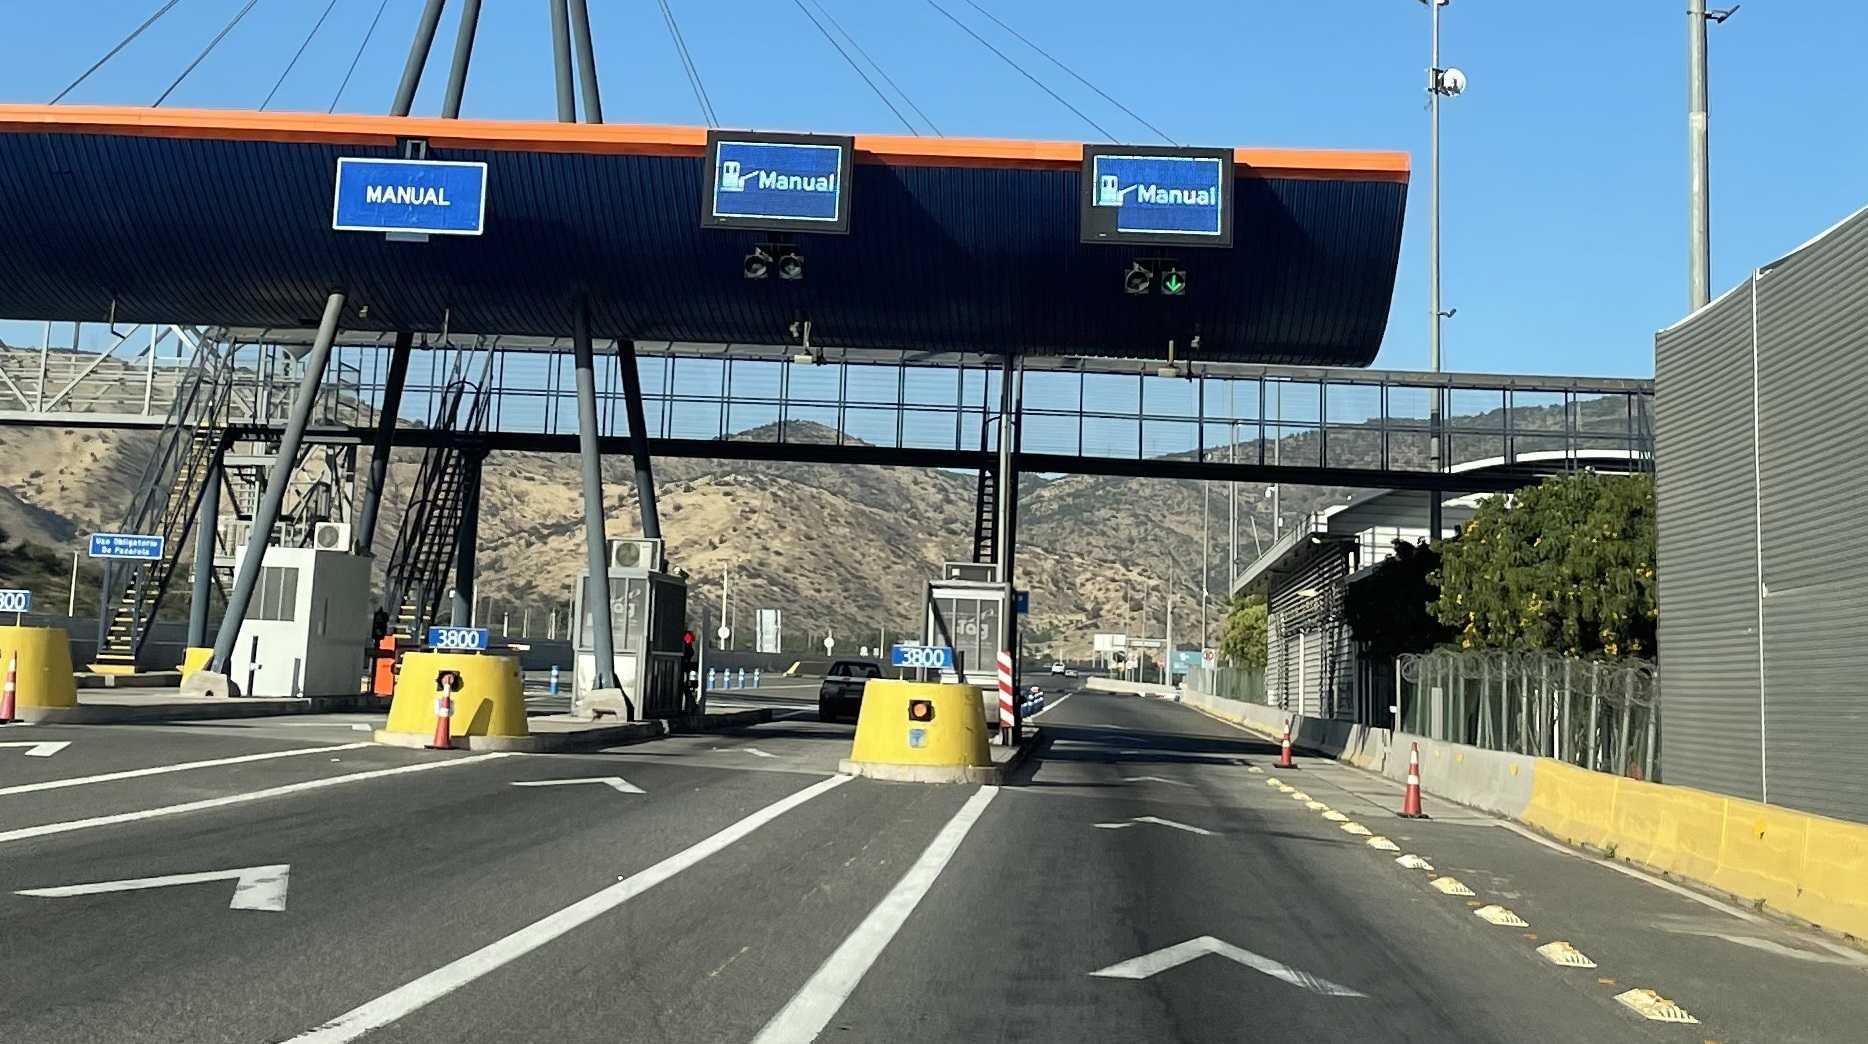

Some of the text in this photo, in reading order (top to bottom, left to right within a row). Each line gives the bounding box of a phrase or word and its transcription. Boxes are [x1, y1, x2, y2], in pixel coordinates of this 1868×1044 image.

[758, 169, 835, 192] Manual
[366, 185, 450, 206] MANUAL
[1137, 184, 1216, 206] Manual
[437, 629, 480, 648] 3800
[902, 647, 945, 667] 3800
